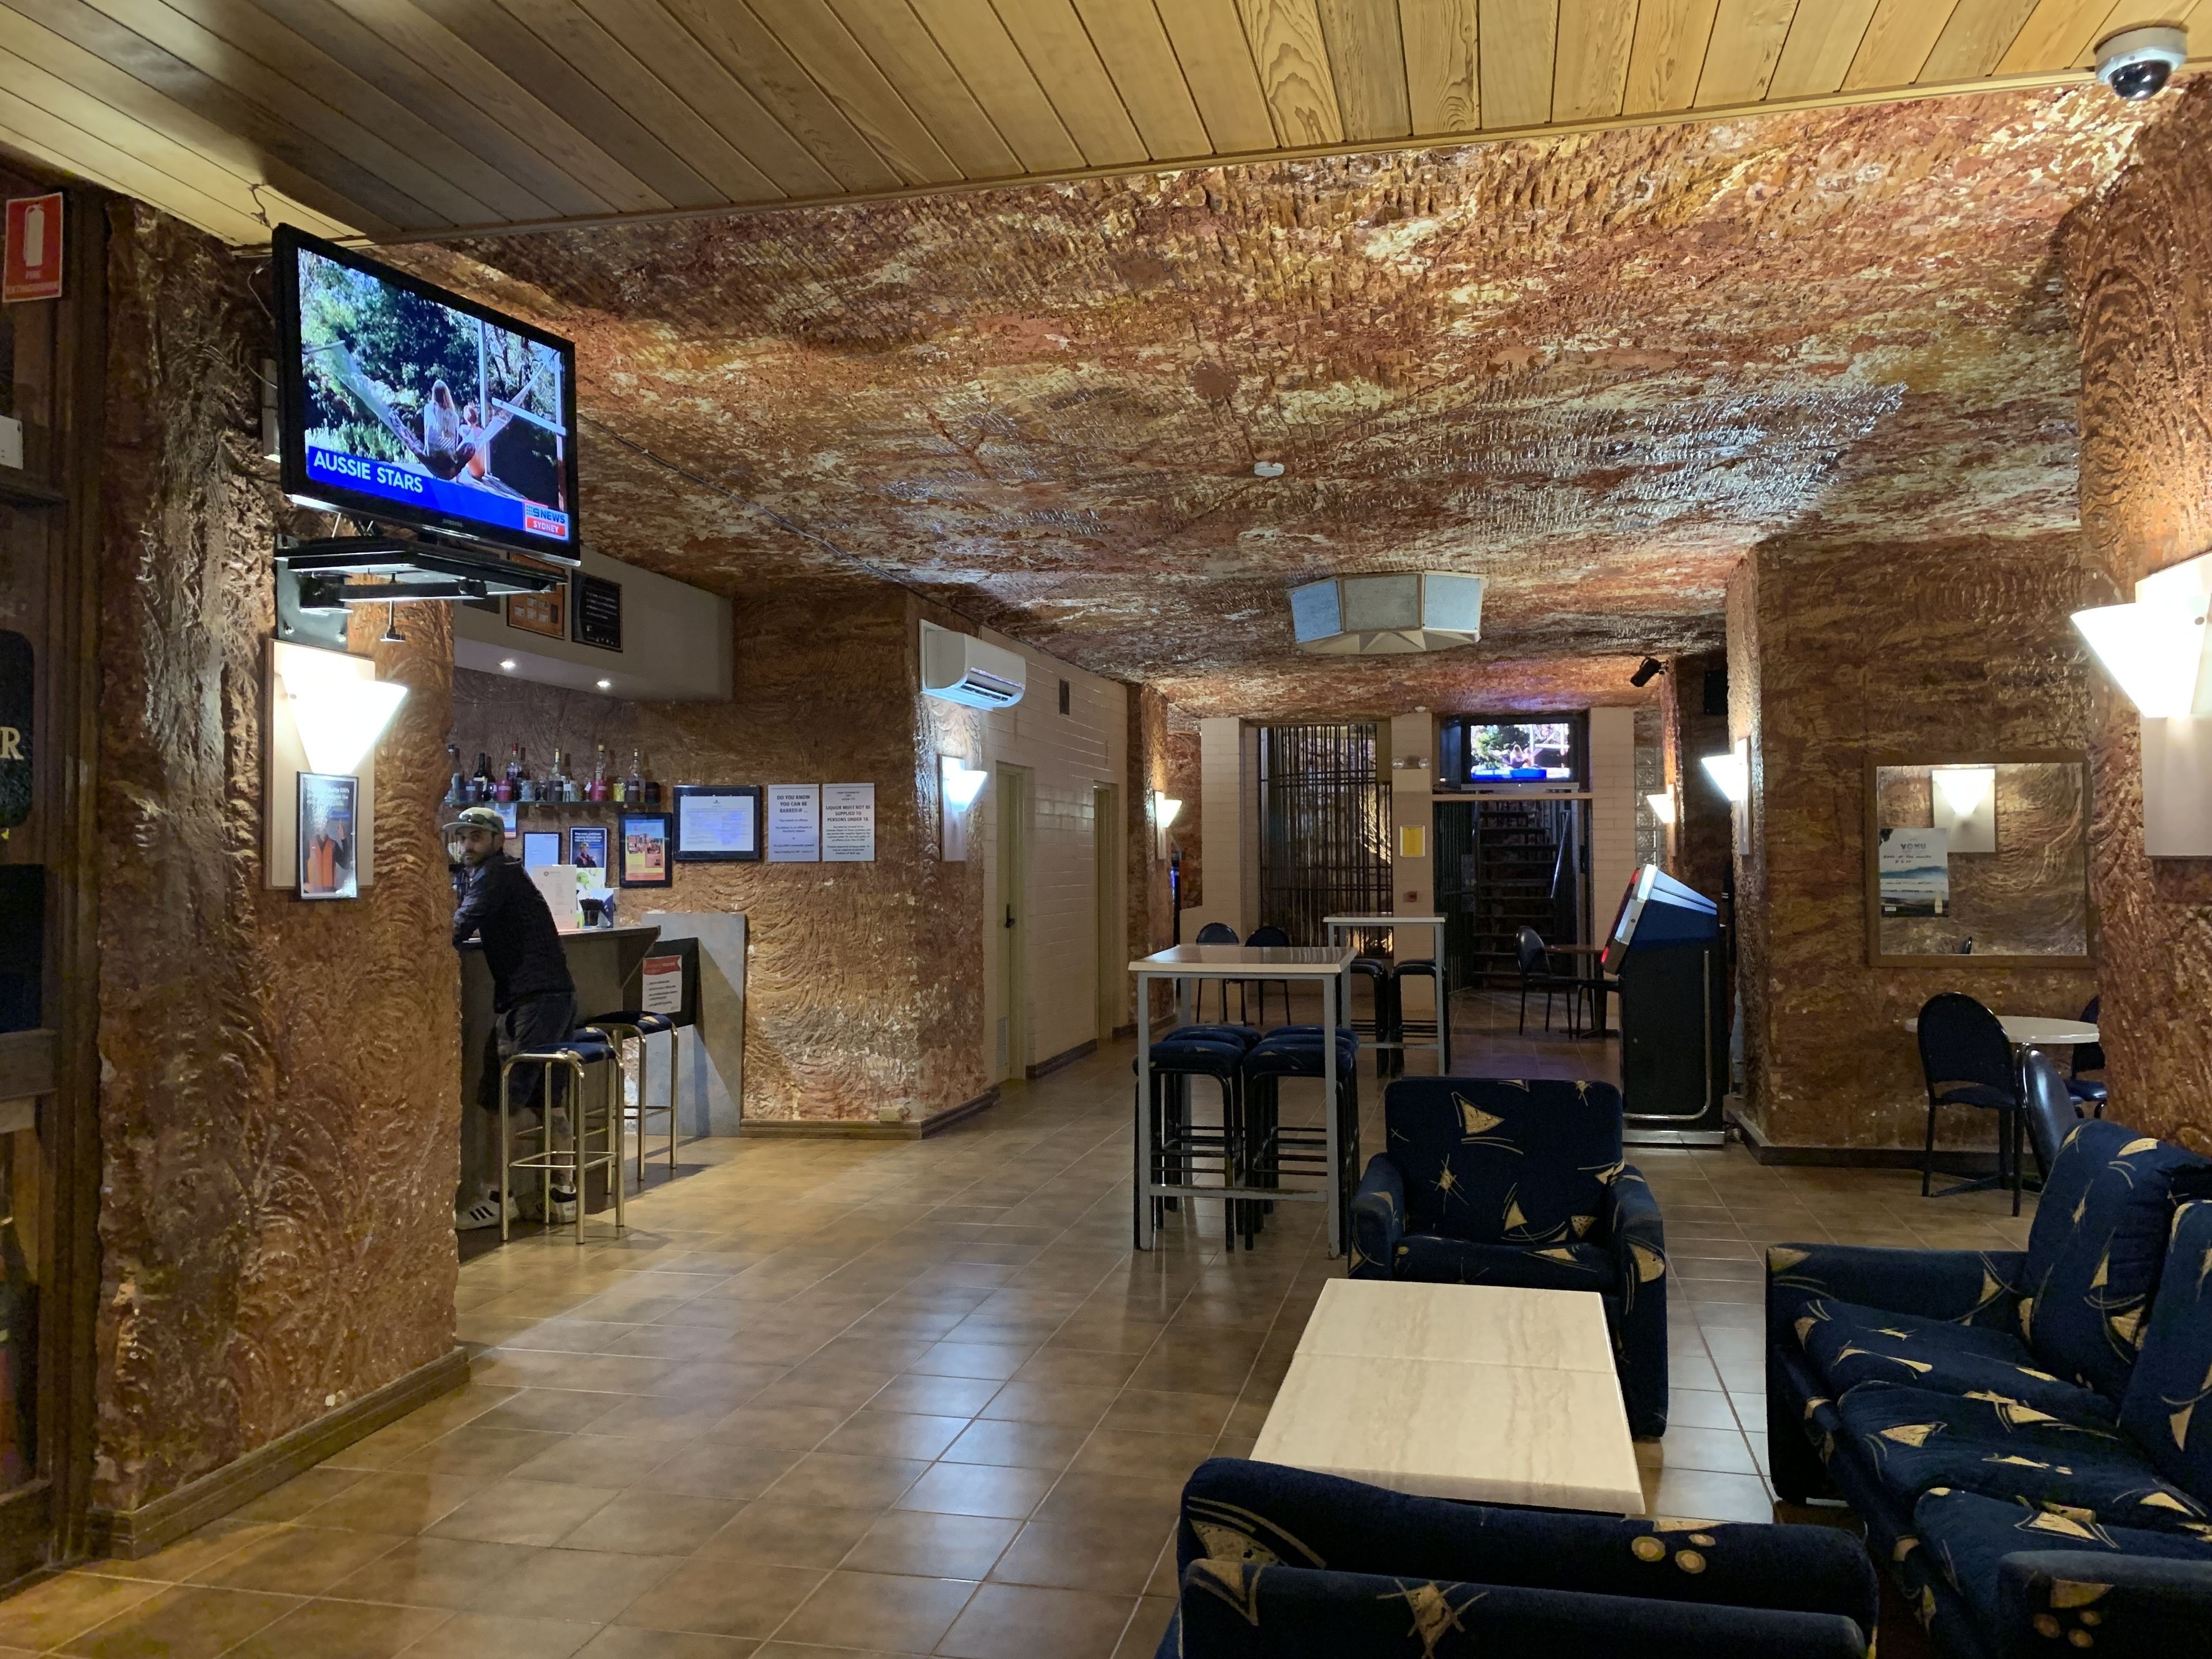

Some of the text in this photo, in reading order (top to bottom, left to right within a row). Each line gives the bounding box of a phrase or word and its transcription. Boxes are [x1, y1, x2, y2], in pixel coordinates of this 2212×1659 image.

[313, 450, 423, 493] AUSSIE STARS
[540, 509, 565, 524] NEWS
[533, 520, 559, 533] SYDNEY
